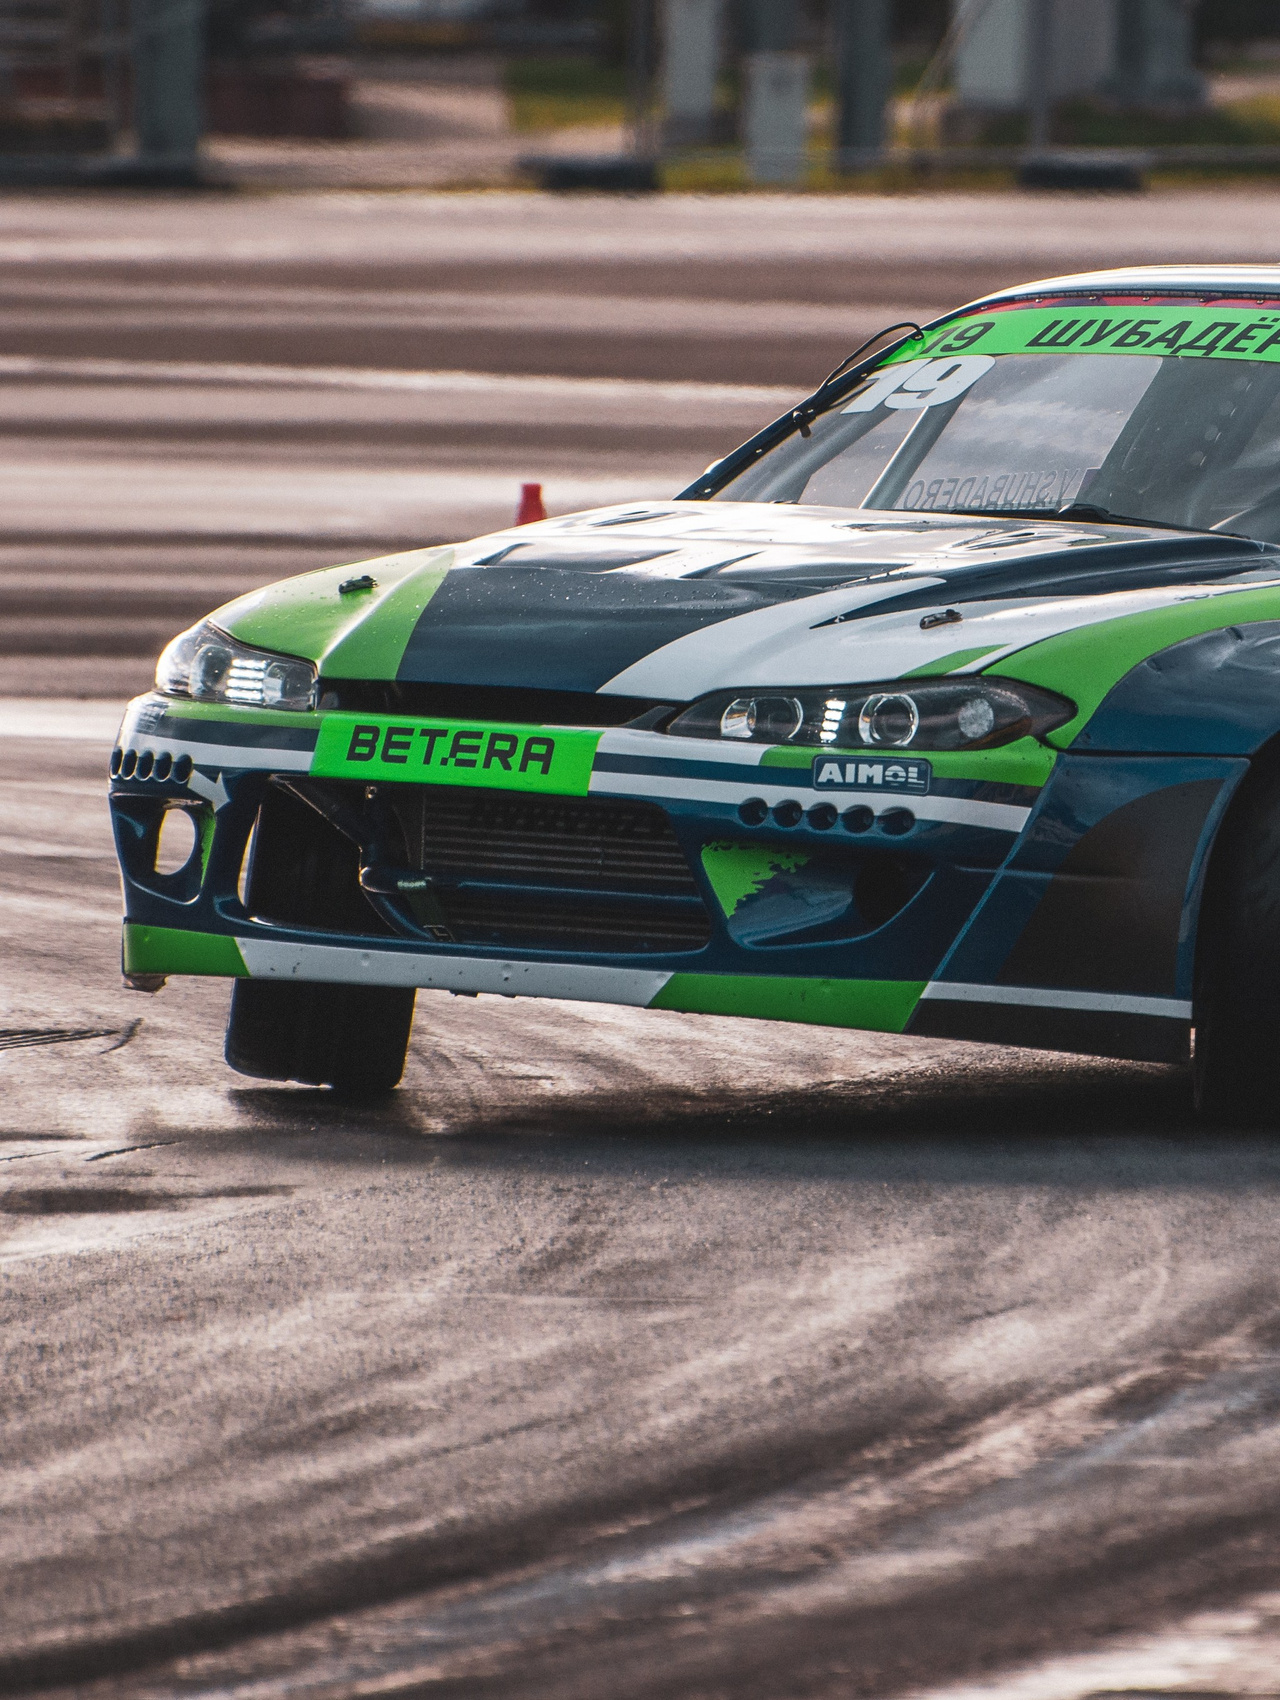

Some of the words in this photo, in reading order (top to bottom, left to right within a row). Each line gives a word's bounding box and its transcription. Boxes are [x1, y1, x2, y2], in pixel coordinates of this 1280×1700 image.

[920, 321, 996, 355] 19
[840, 354, 996, 414] 19
[346, 724, 555, 775] BET.ERA
[817, 763, 925, 788] AIMOL
